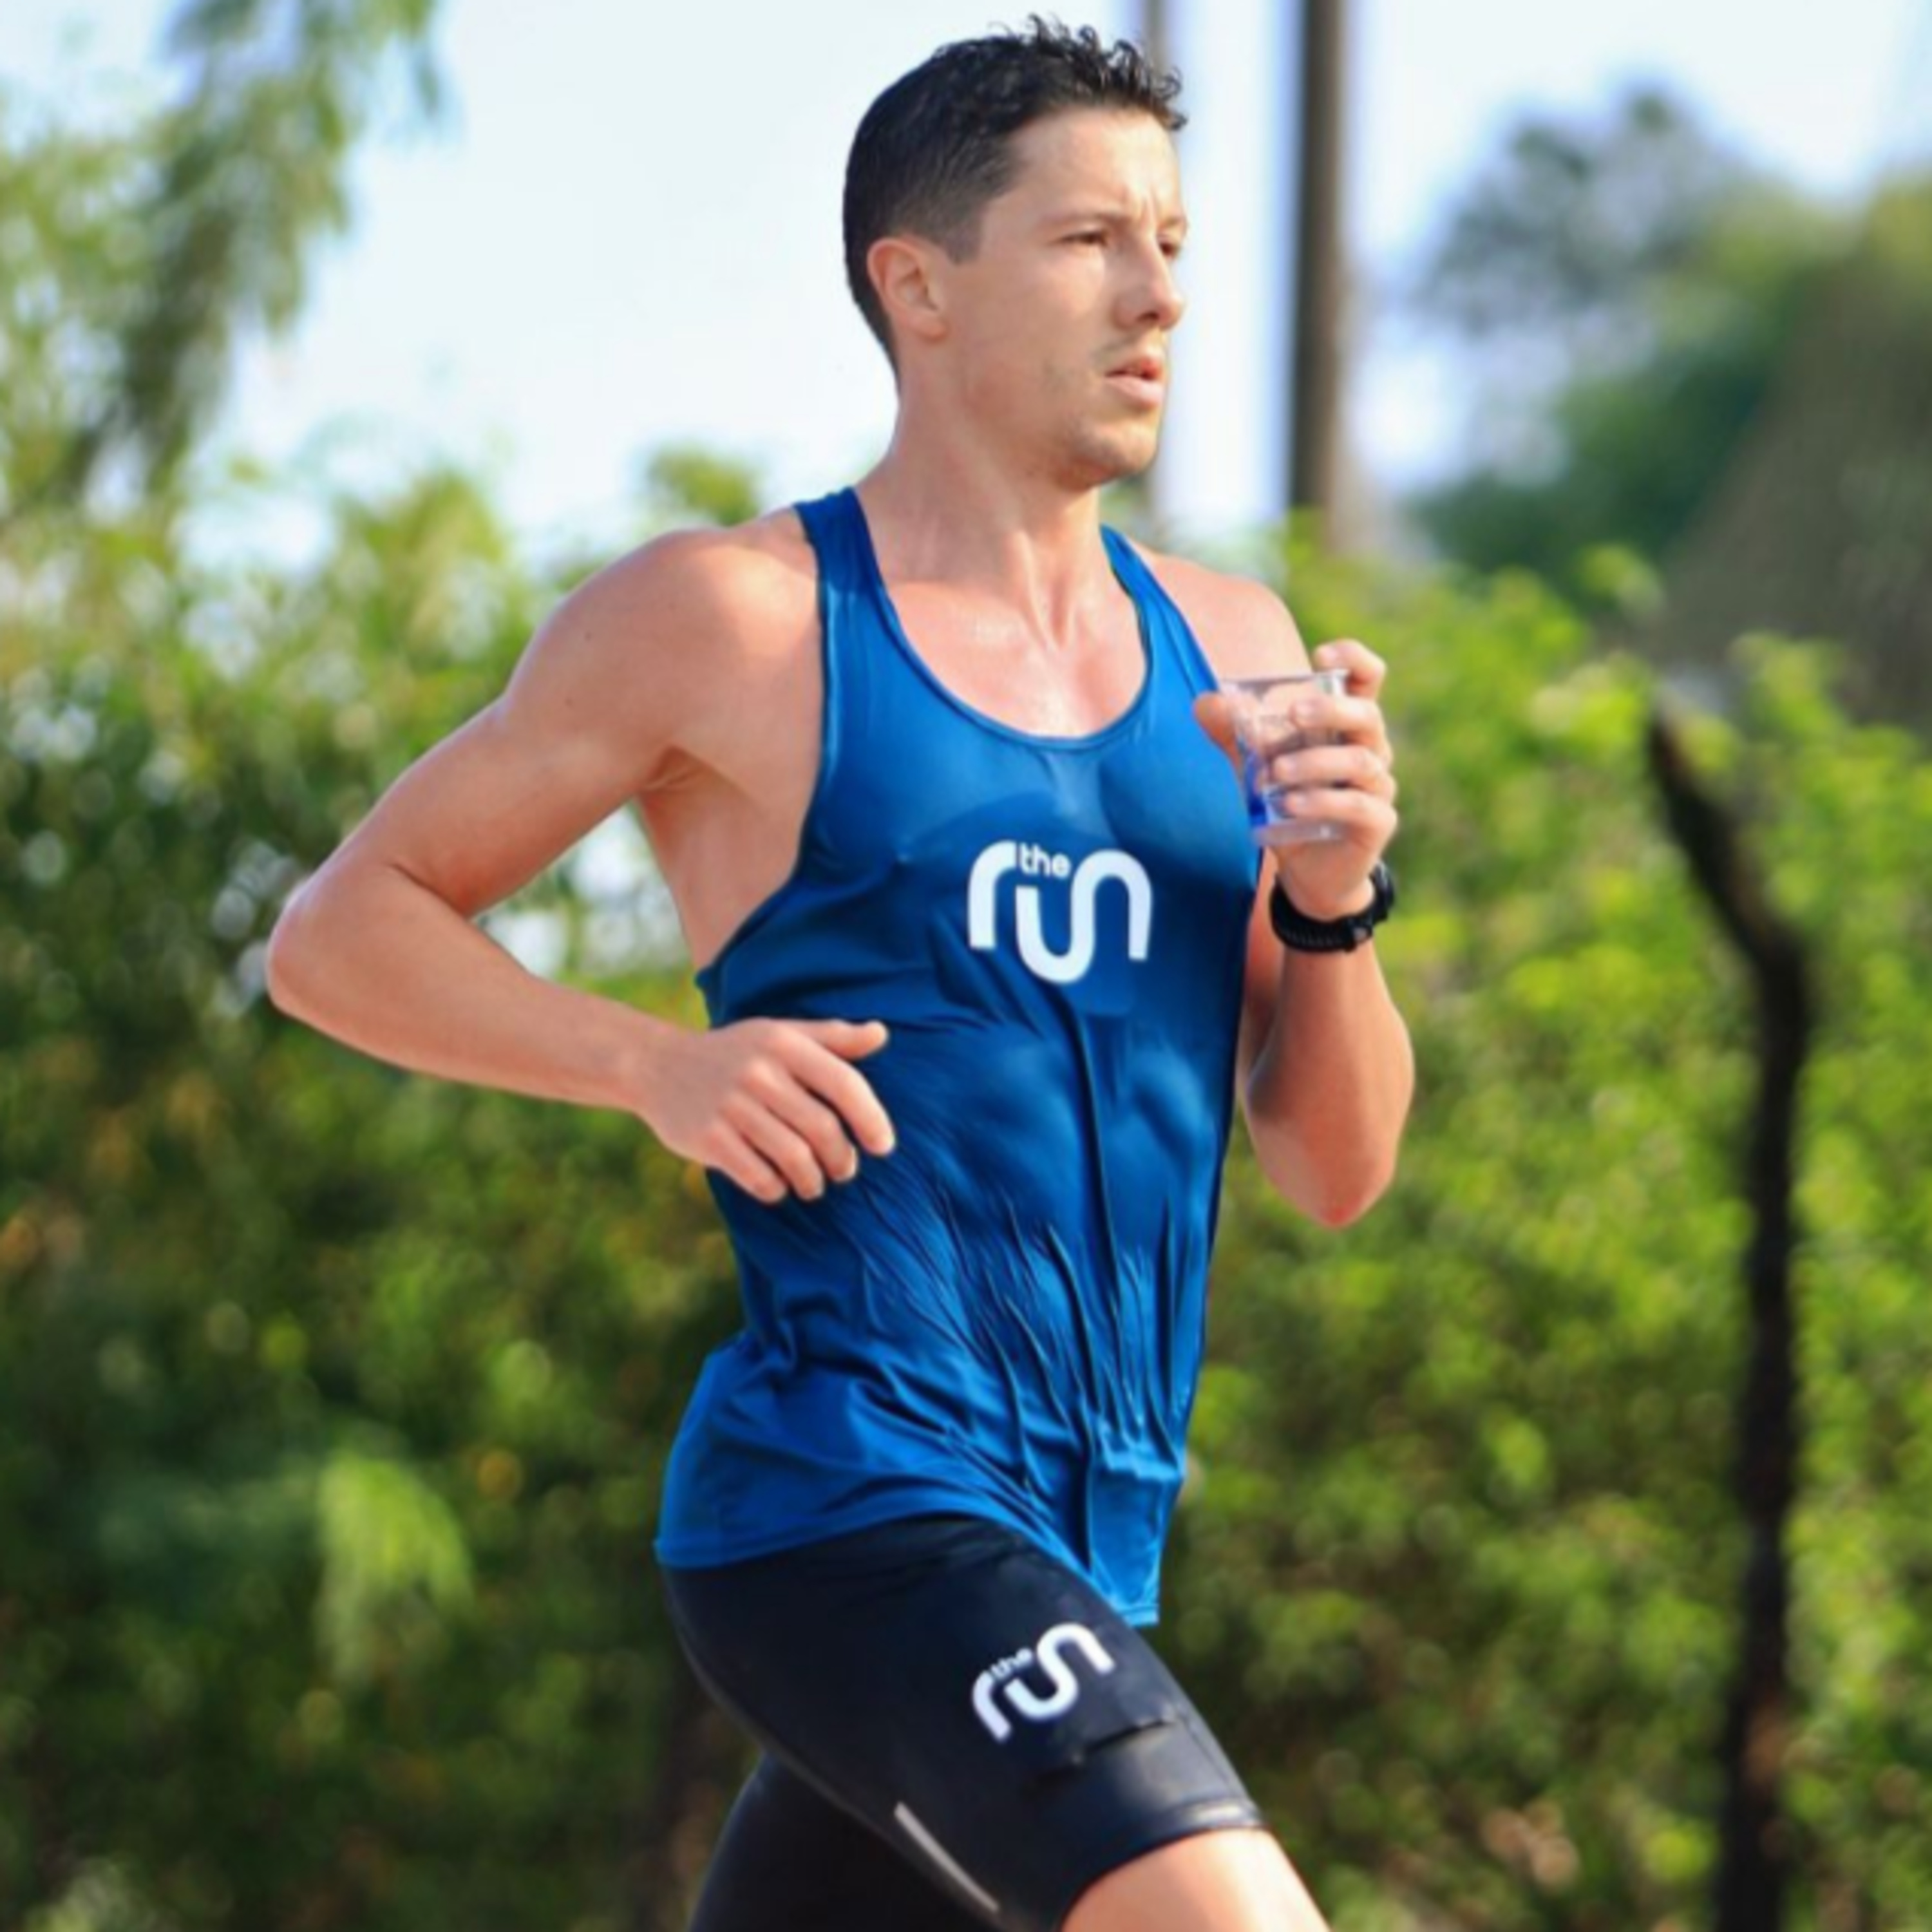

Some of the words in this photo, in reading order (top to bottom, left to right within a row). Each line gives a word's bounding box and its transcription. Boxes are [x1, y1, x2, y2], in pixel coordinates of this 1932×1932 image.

[968, 840, 1151, 984] run
[1019, 842, 1071, 880] the
[973, 1622, 1115, 1741] run
